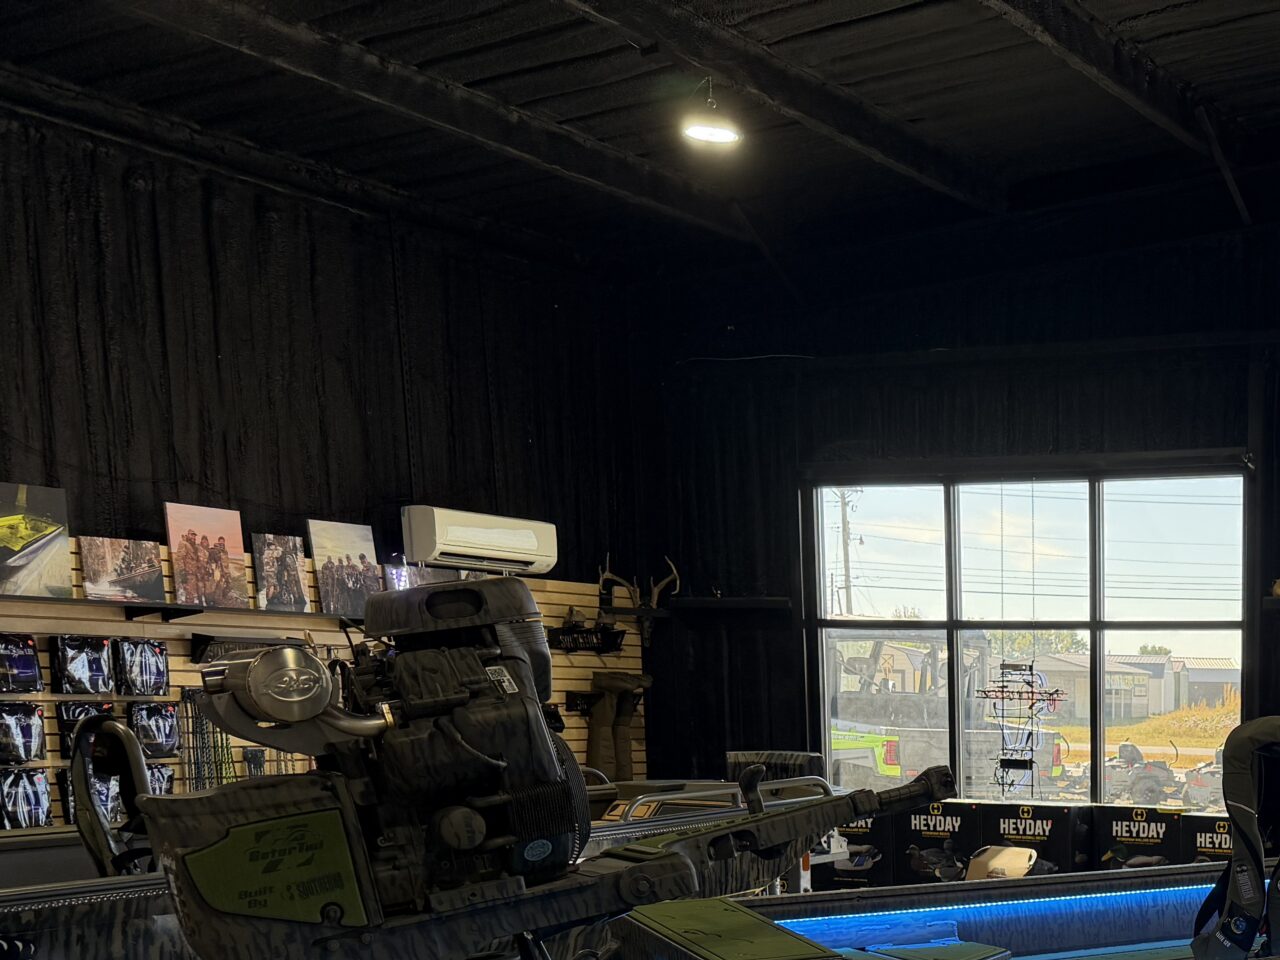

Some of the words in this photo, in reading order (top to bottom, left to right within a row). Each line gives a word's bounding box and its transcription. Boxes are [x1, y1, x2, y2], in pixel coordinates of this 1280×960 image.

[911, 815, 961, 832] HEYDAY
[1000, 818, 1053, 836] HEYDAY
[1112, 820, 1166, 838] HEYDAY
[1196, 832, 1233, 848] HEYD
